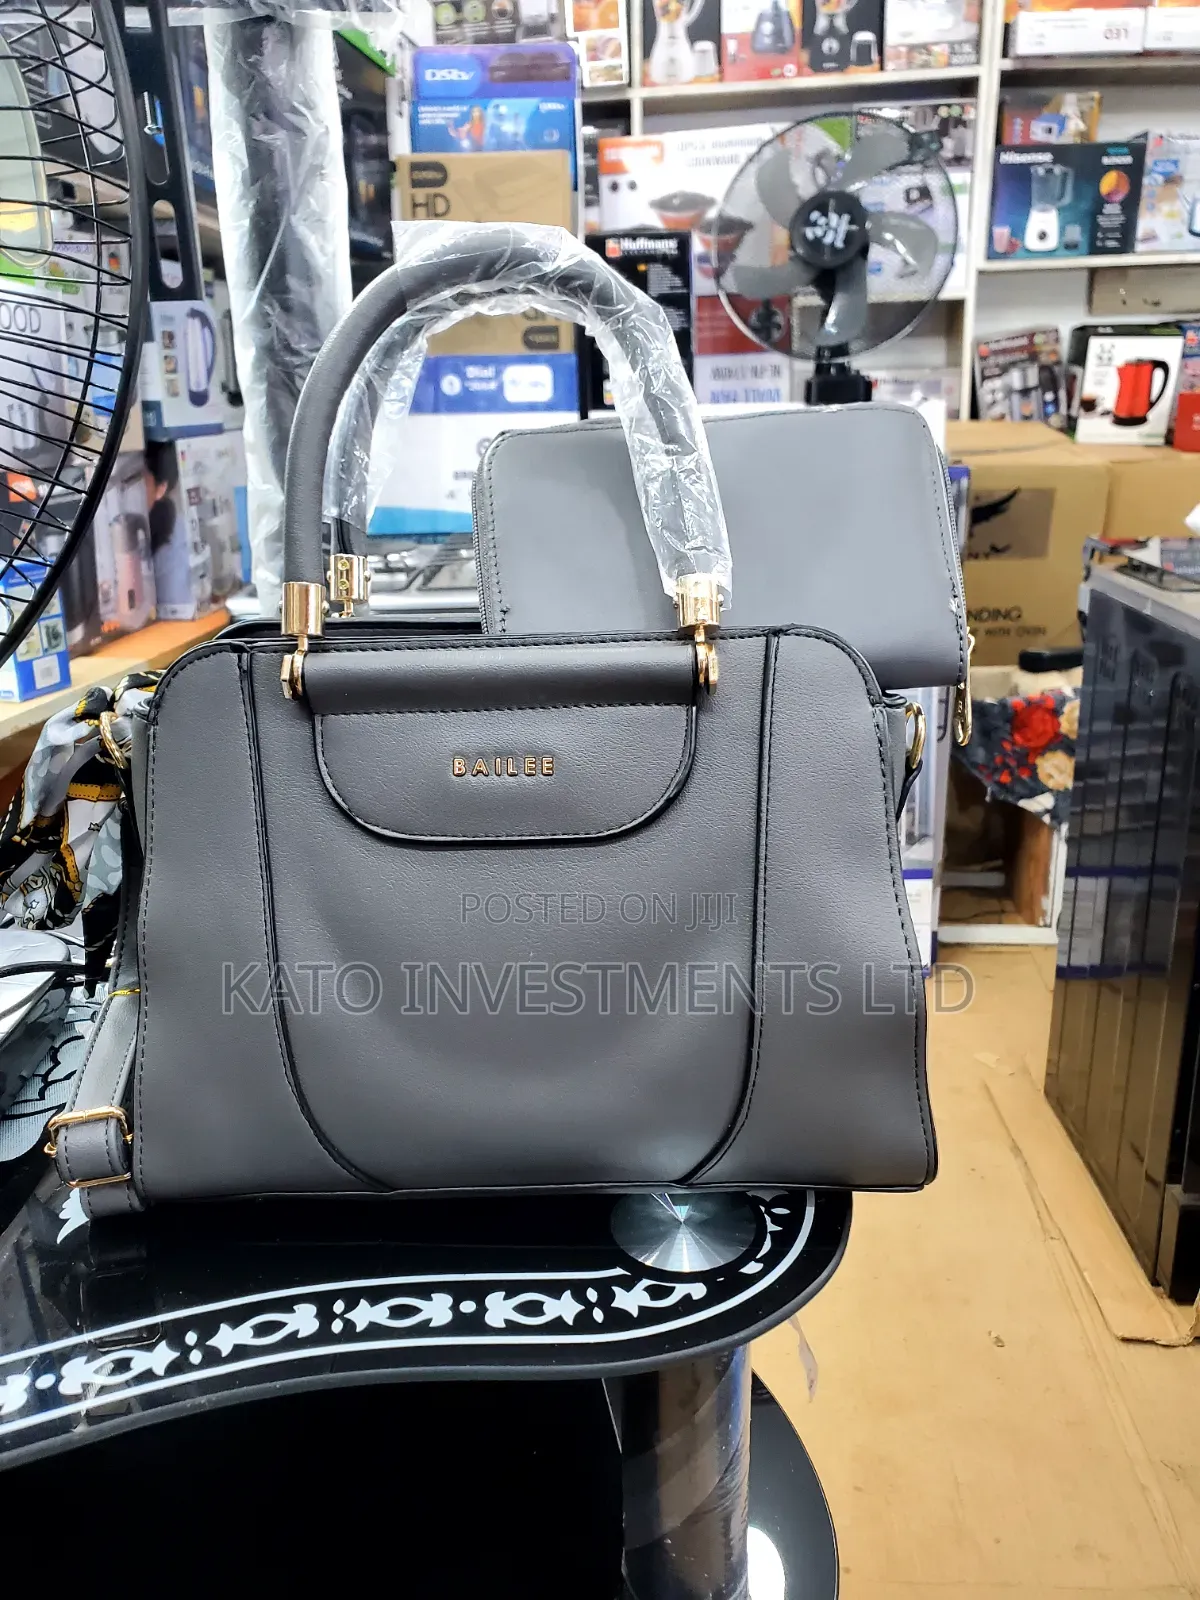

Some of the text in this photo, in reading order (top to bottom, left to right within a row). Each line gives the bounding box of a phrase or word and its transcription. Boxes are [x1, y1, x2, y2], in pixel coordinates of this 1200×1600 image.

[411, 192, 451, 218] HD
[0, 303, 42, 334] OOD
[967, 605, 1023, 623] NDING
[452, 756, 556, 777] BAILEE
